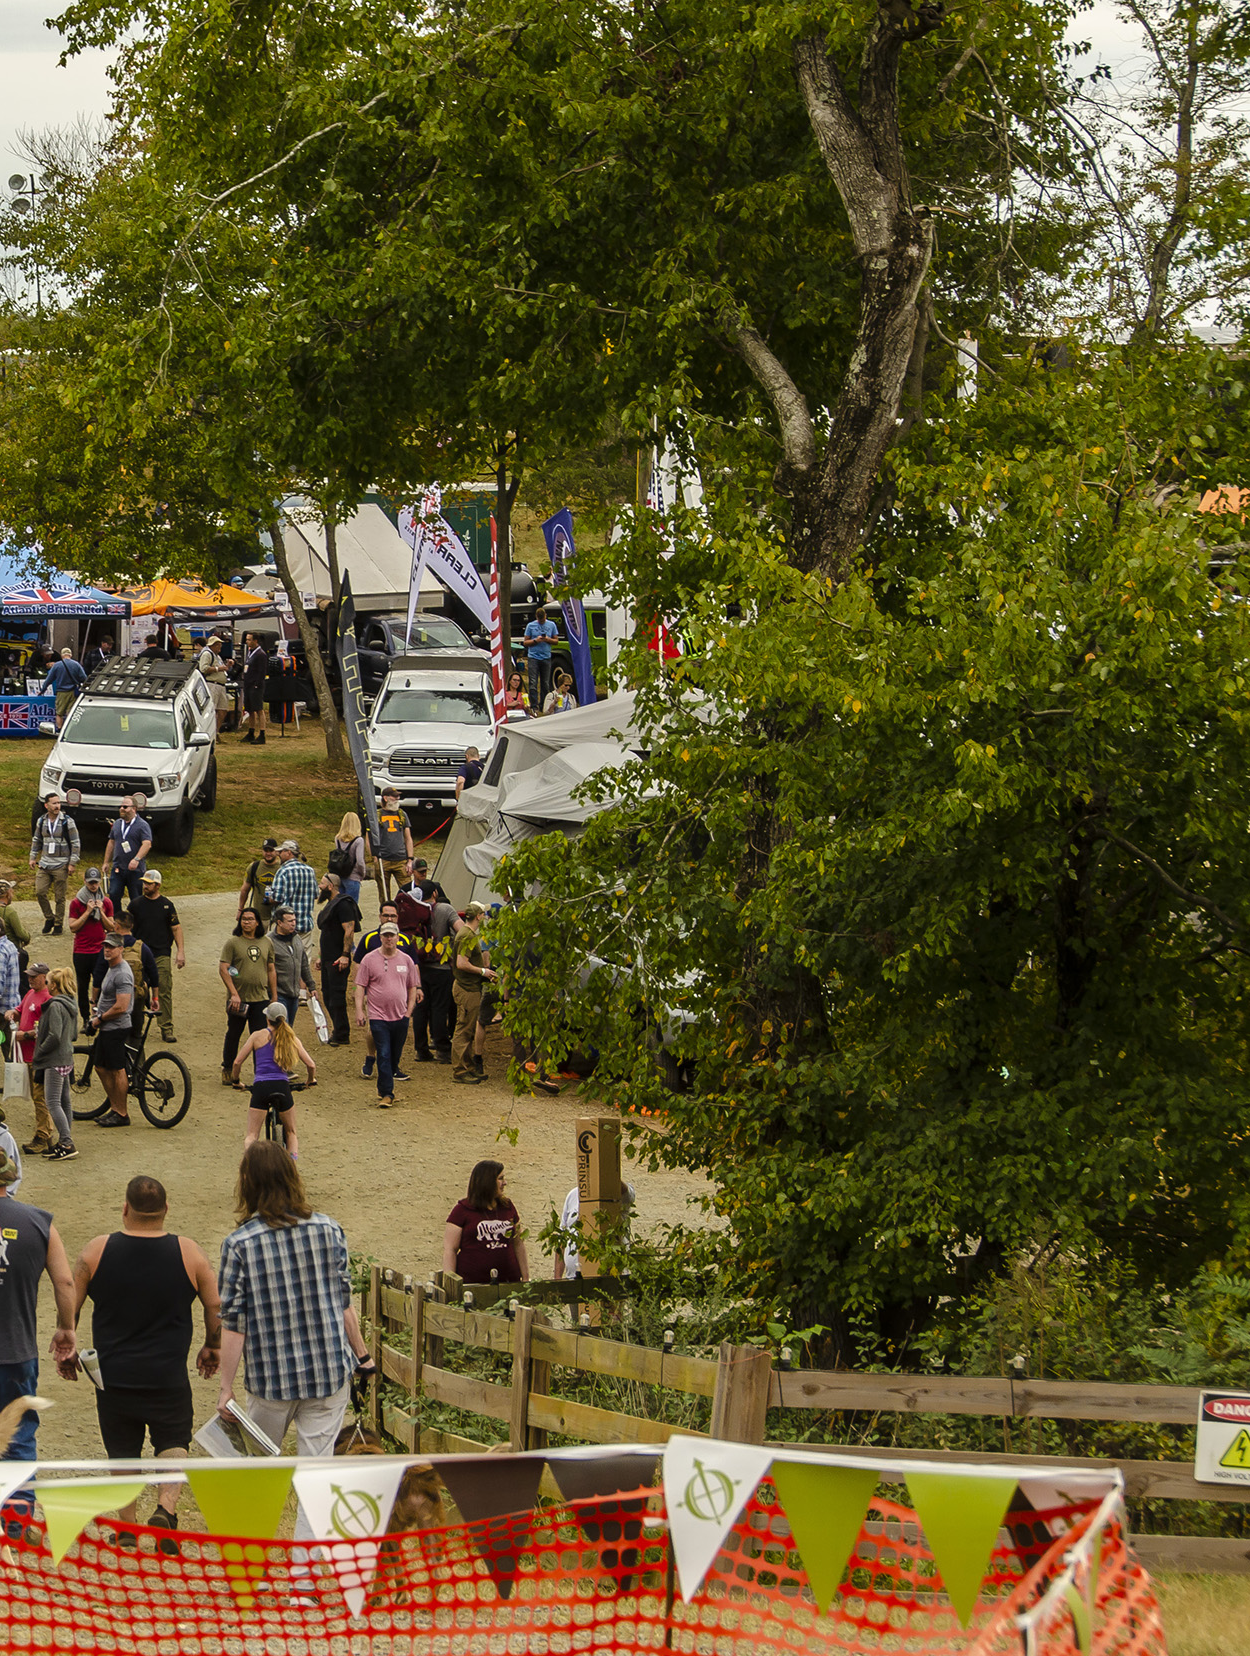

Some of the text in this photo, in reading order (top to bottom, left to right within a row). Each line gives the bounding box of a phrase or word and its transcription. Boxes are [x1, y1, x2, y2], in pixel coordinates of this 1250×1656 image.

[3, 603, 106, 615] Atlantic British Ltd.
[91, 781, 126, 790] TOYOTA
[578, 1155, 587, 1199] PRINSU
[1213, 1470, 1232, 1479] HIGH
